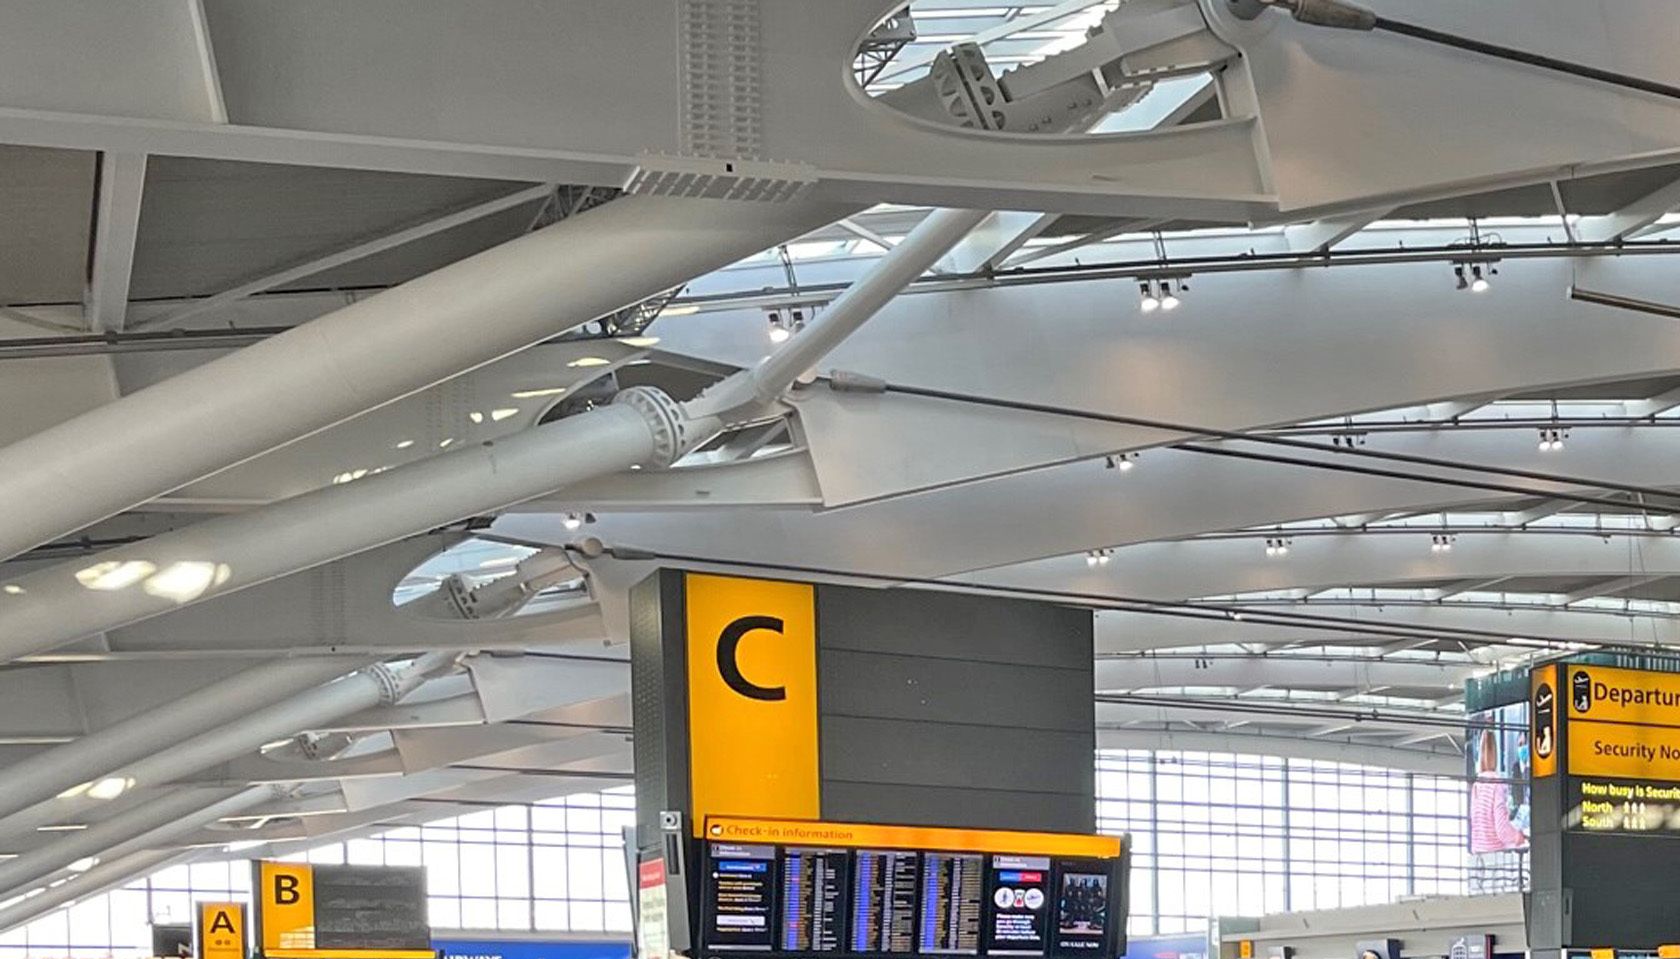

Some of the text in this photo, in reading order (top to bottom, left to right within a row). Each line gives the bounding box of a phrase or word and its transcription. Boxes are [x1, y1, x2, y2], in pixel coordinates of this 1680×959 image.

[716, 615, 786, 701] C
[1594, 740, 1656, 762] Security
[1582, 782, 1607, 795] How
[1609, 783, 1633, 799] busy
[1635, 785, 1645, 797] is
[1582, 801, 1613, 814] North
[1582, 816, 1614, 828] South
[727, 825, 853, 840] Check-in information
[275, 874, 300, 905] B
[209, 911, 235, 933] A
